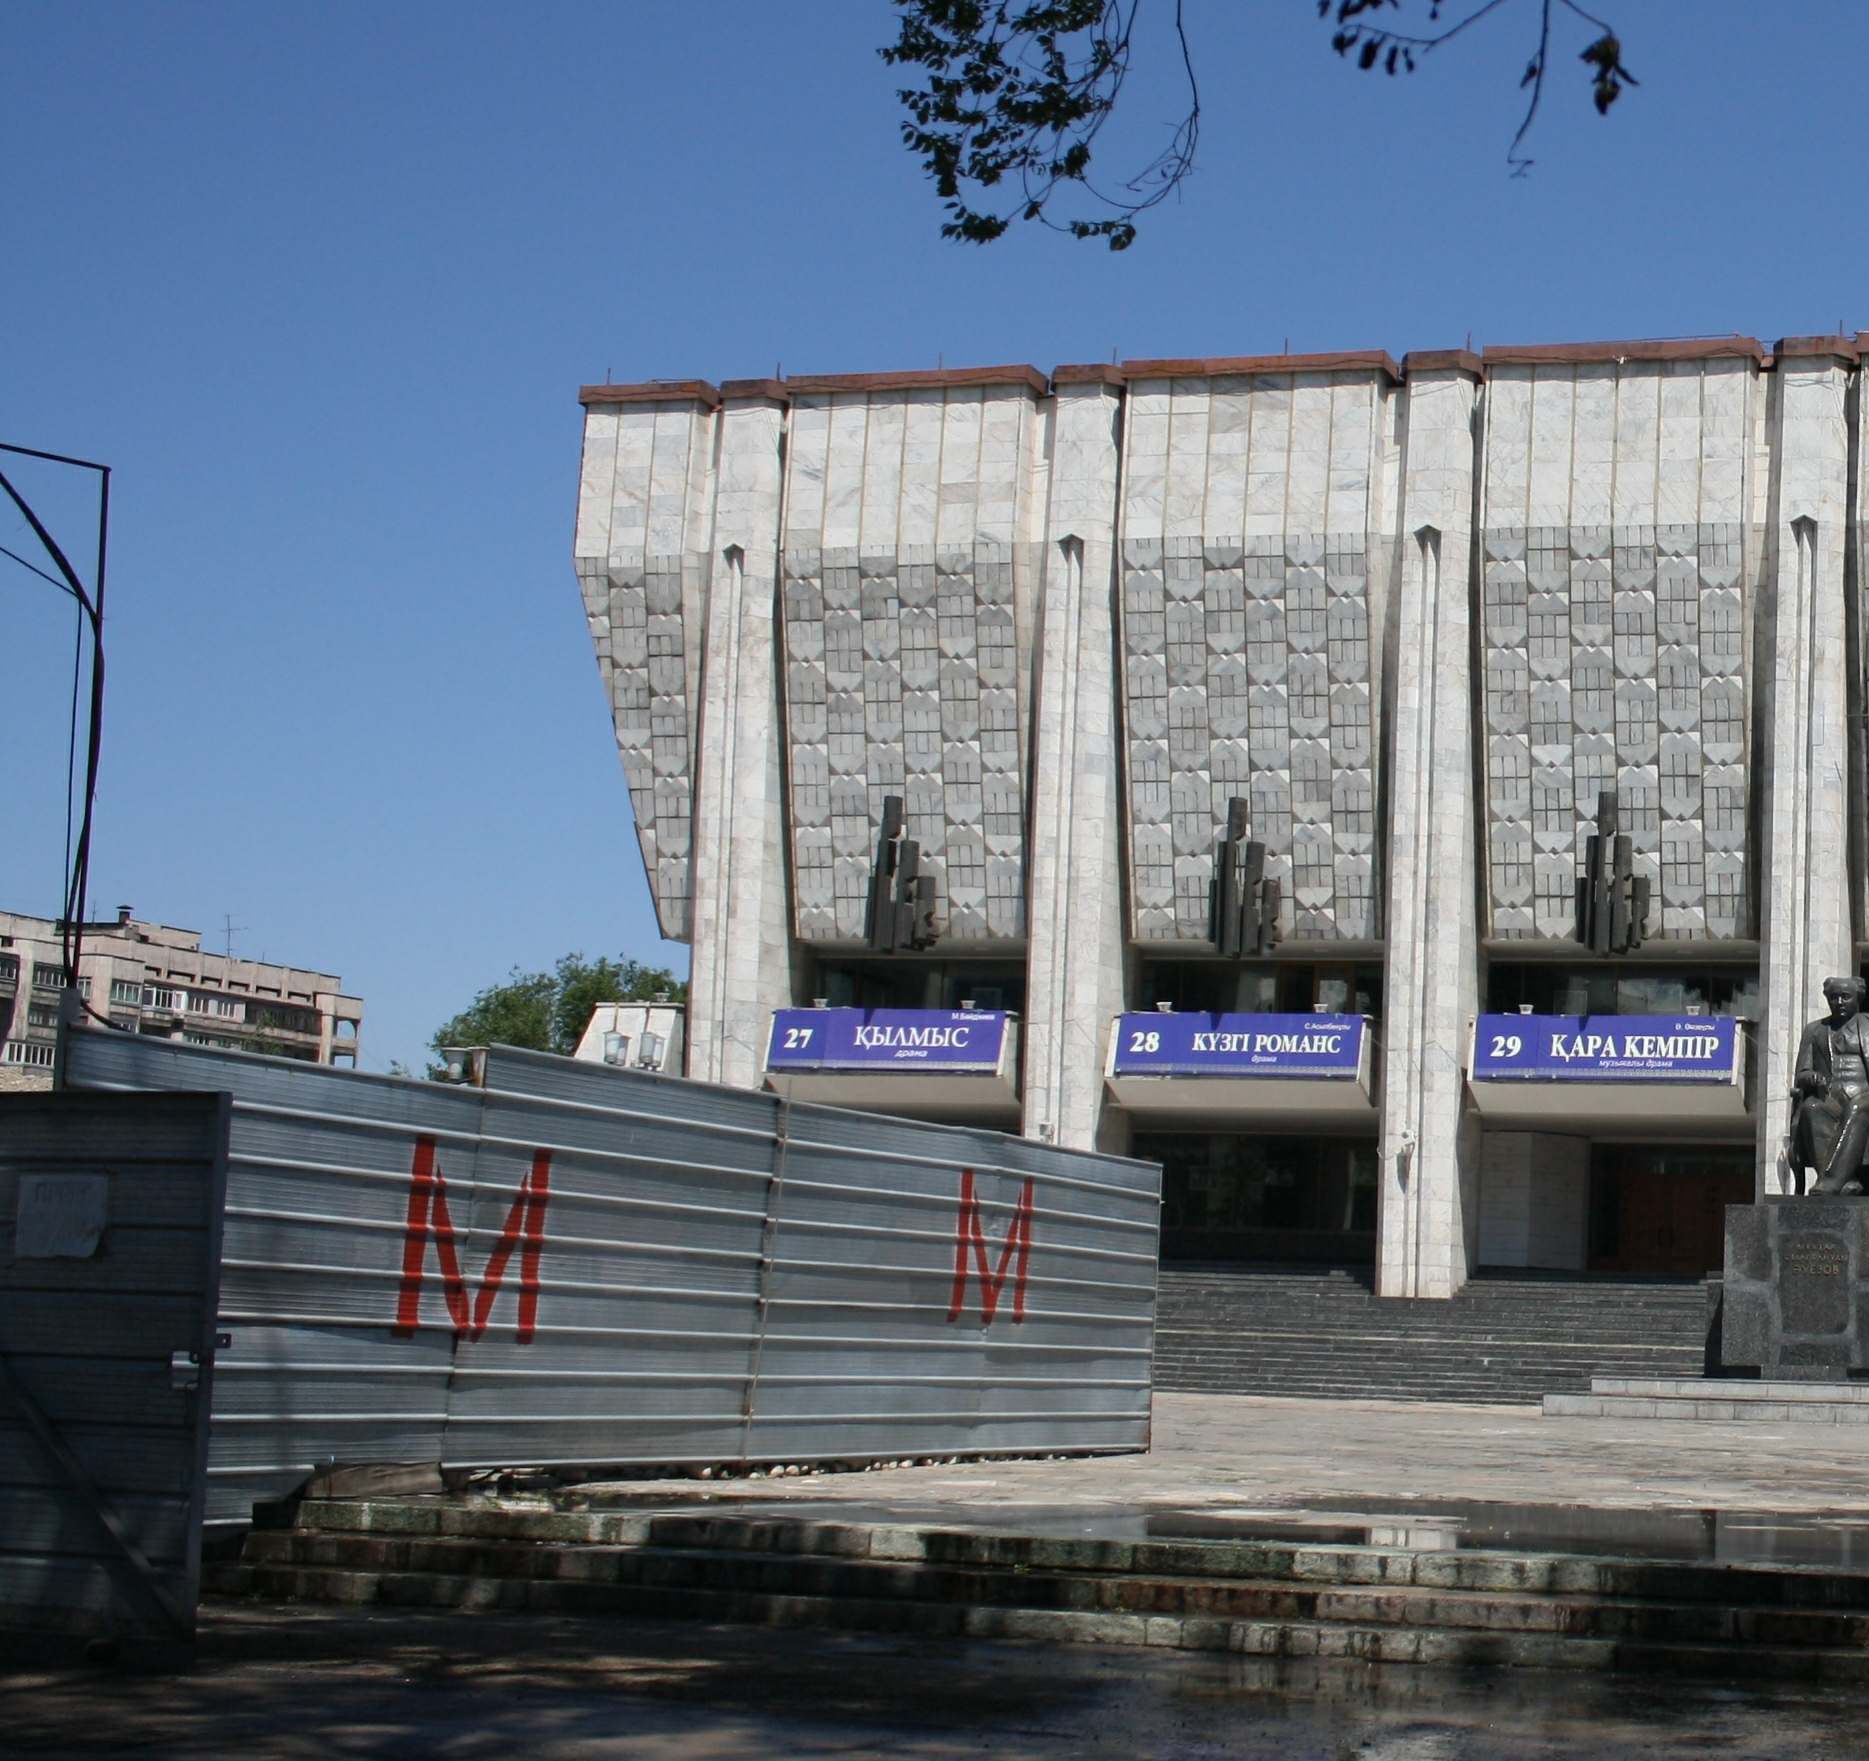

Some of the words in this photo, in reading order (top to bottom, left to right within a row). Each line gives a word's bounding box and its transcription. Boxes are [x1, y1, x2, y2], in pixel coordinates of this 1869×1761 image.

[783, 1028, 814, 1049] 27
[853, 1025, 970, 1050] ҚЫЛМЫС
[1129, 1031, 1160, 1053] 28
[1191, 1032, 1250, 1052] КҮЗГІ
[1253, 1034, 1341, 1053] РОМАНС
[1490, 1035, 1522, 1058] 29
[1550, 1034, 1617, 1062] ҚАРА
[1623, 1035, 1719, 1059] КЕМПІР
